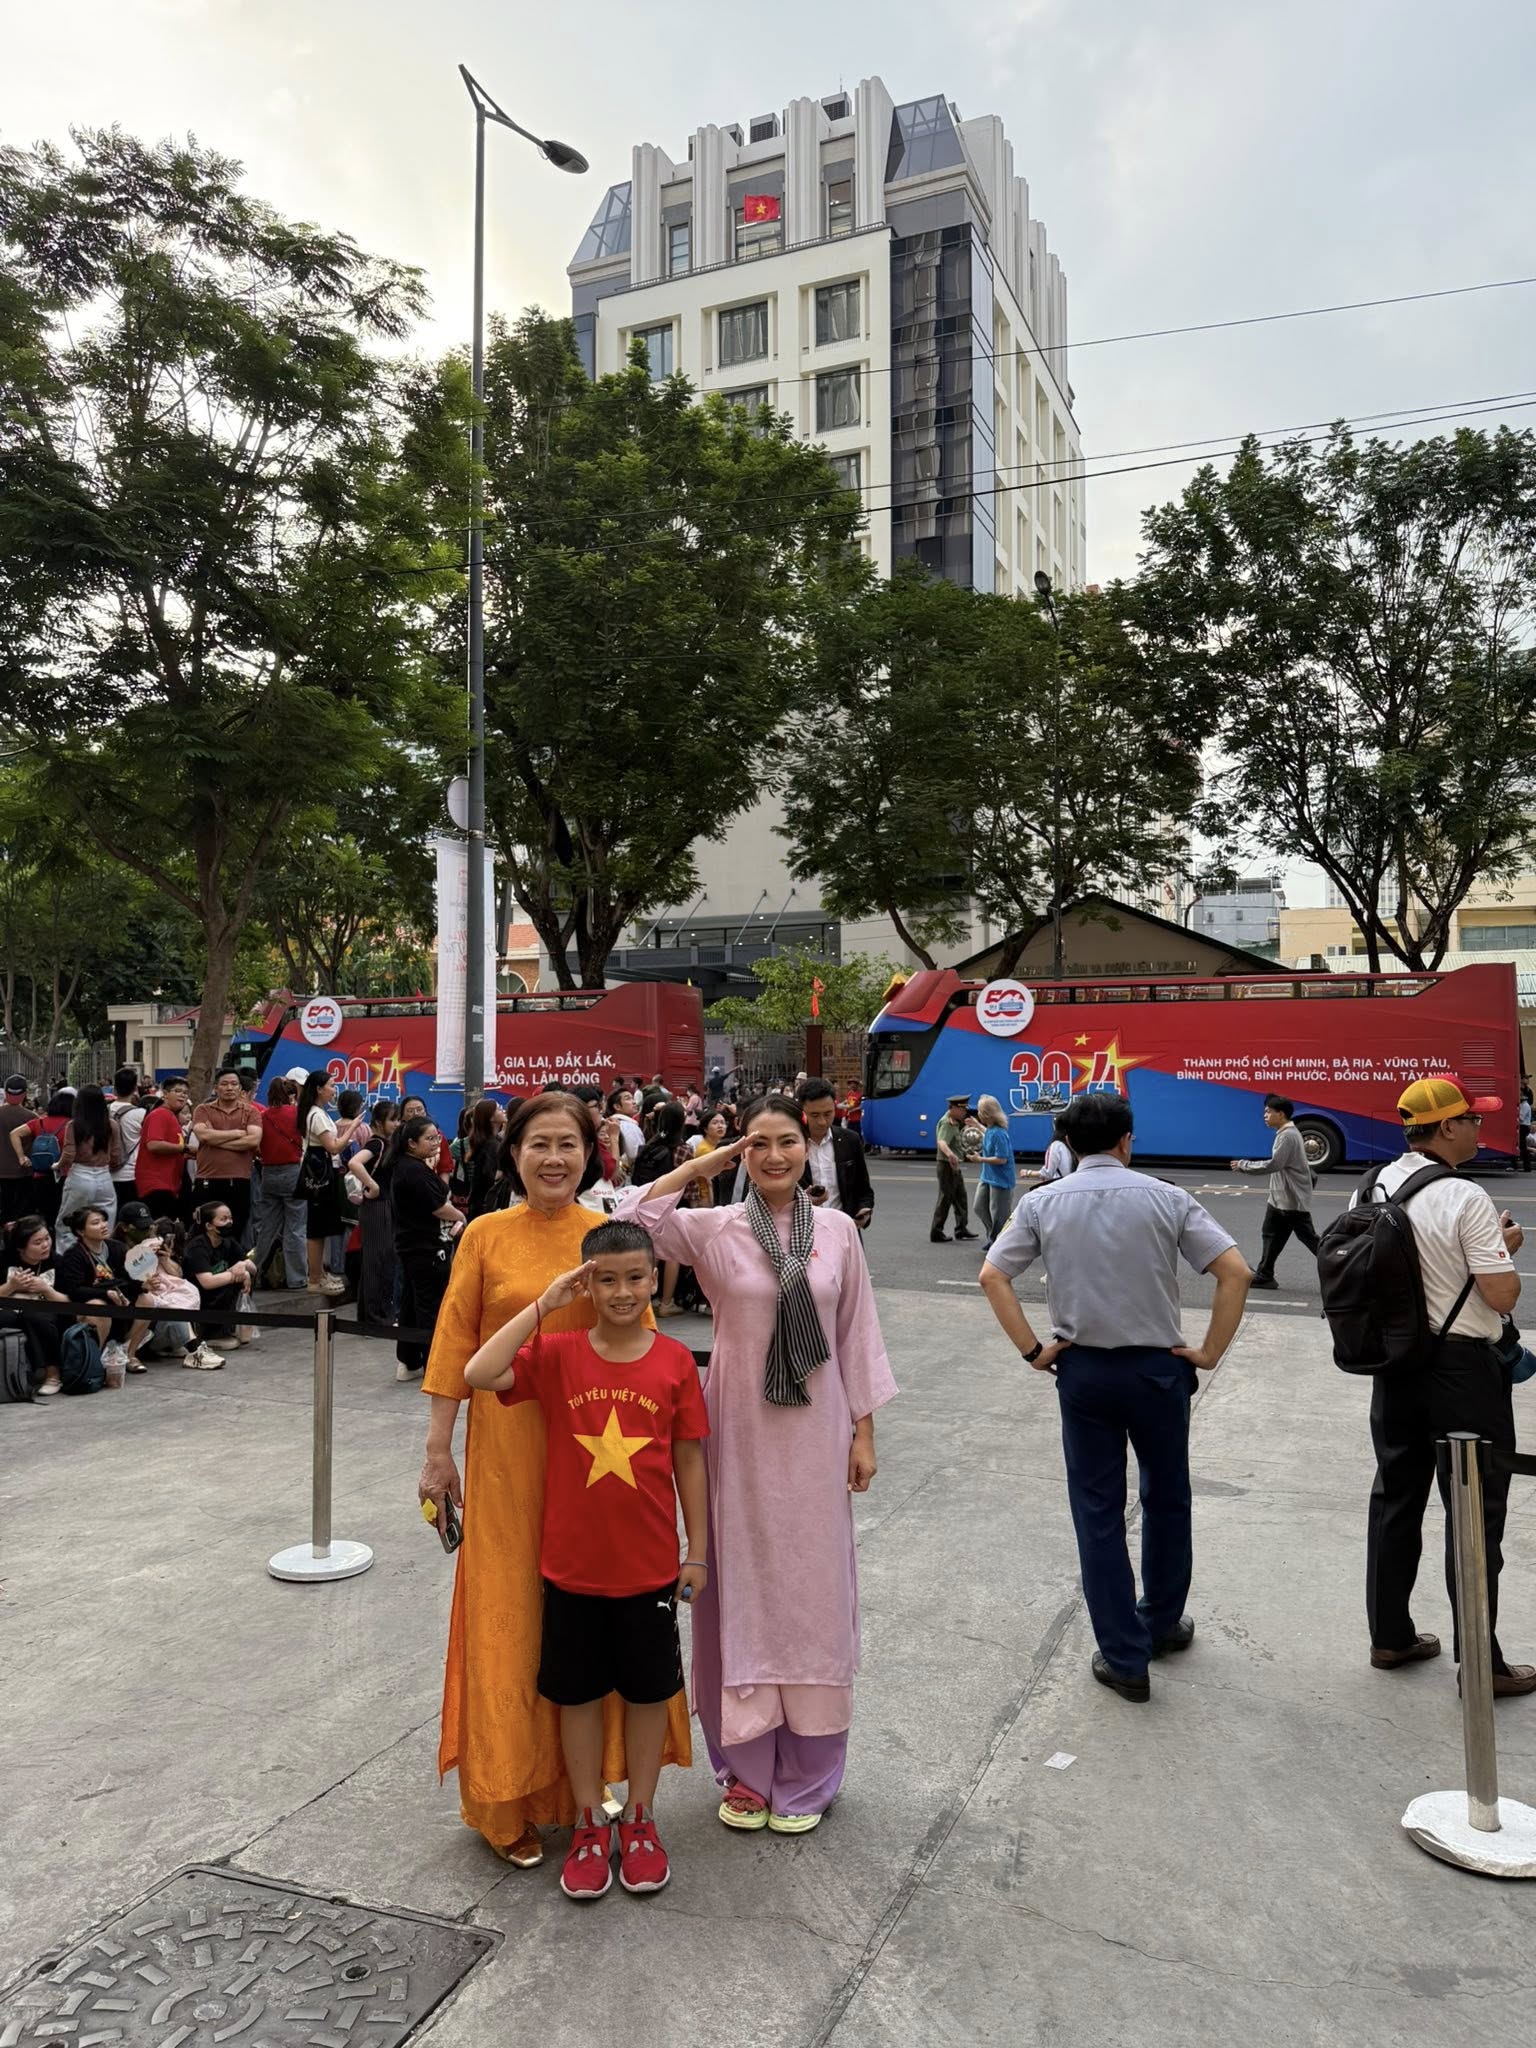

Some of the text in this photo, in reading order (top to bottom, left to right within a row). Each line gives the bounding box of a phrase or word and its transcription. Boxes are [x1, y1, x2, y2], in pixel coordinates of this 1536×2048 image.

[504, 1050, 616, 1069] GIA LAI, ĐẮK LẮK,
[1184, 1056, 1222, 1067] THÀNH
[1225, 1055, 1250, 1067] PHỐ
[1272, 1056, 1293, 1067] CHÍ
[1296, 1058, 1329, 1069] MINH,
[1333, 1056, 1349, 1067] BÀ
[1353, 1058, 1373, 1069] RỊA
[1384, 1056, 1418, 1067] VŨNG
[1423, 1056, 1451, 1069] TÀU,
[490, 1069, 600, 1086] ÔNG, LÂM ĐỒNG
[1177, 1069, 1203, 1080] BÌNH
[1207, 1070, 1251, 1082] DƯƠNG,
[1255, 1069, 1282, 1080] BÌNH
[1286, 1069, 1331, 1082] PHƯỚC,
[1373, 1071, 1397, 1082] NAI,
[1400, 1069, 1424, 1080] TÂY
[585, 1387, 608, 1401] YÊU
[611, 1388, 636, 1403] VIỆT
[638, 1395, 659, 1415] NAM
